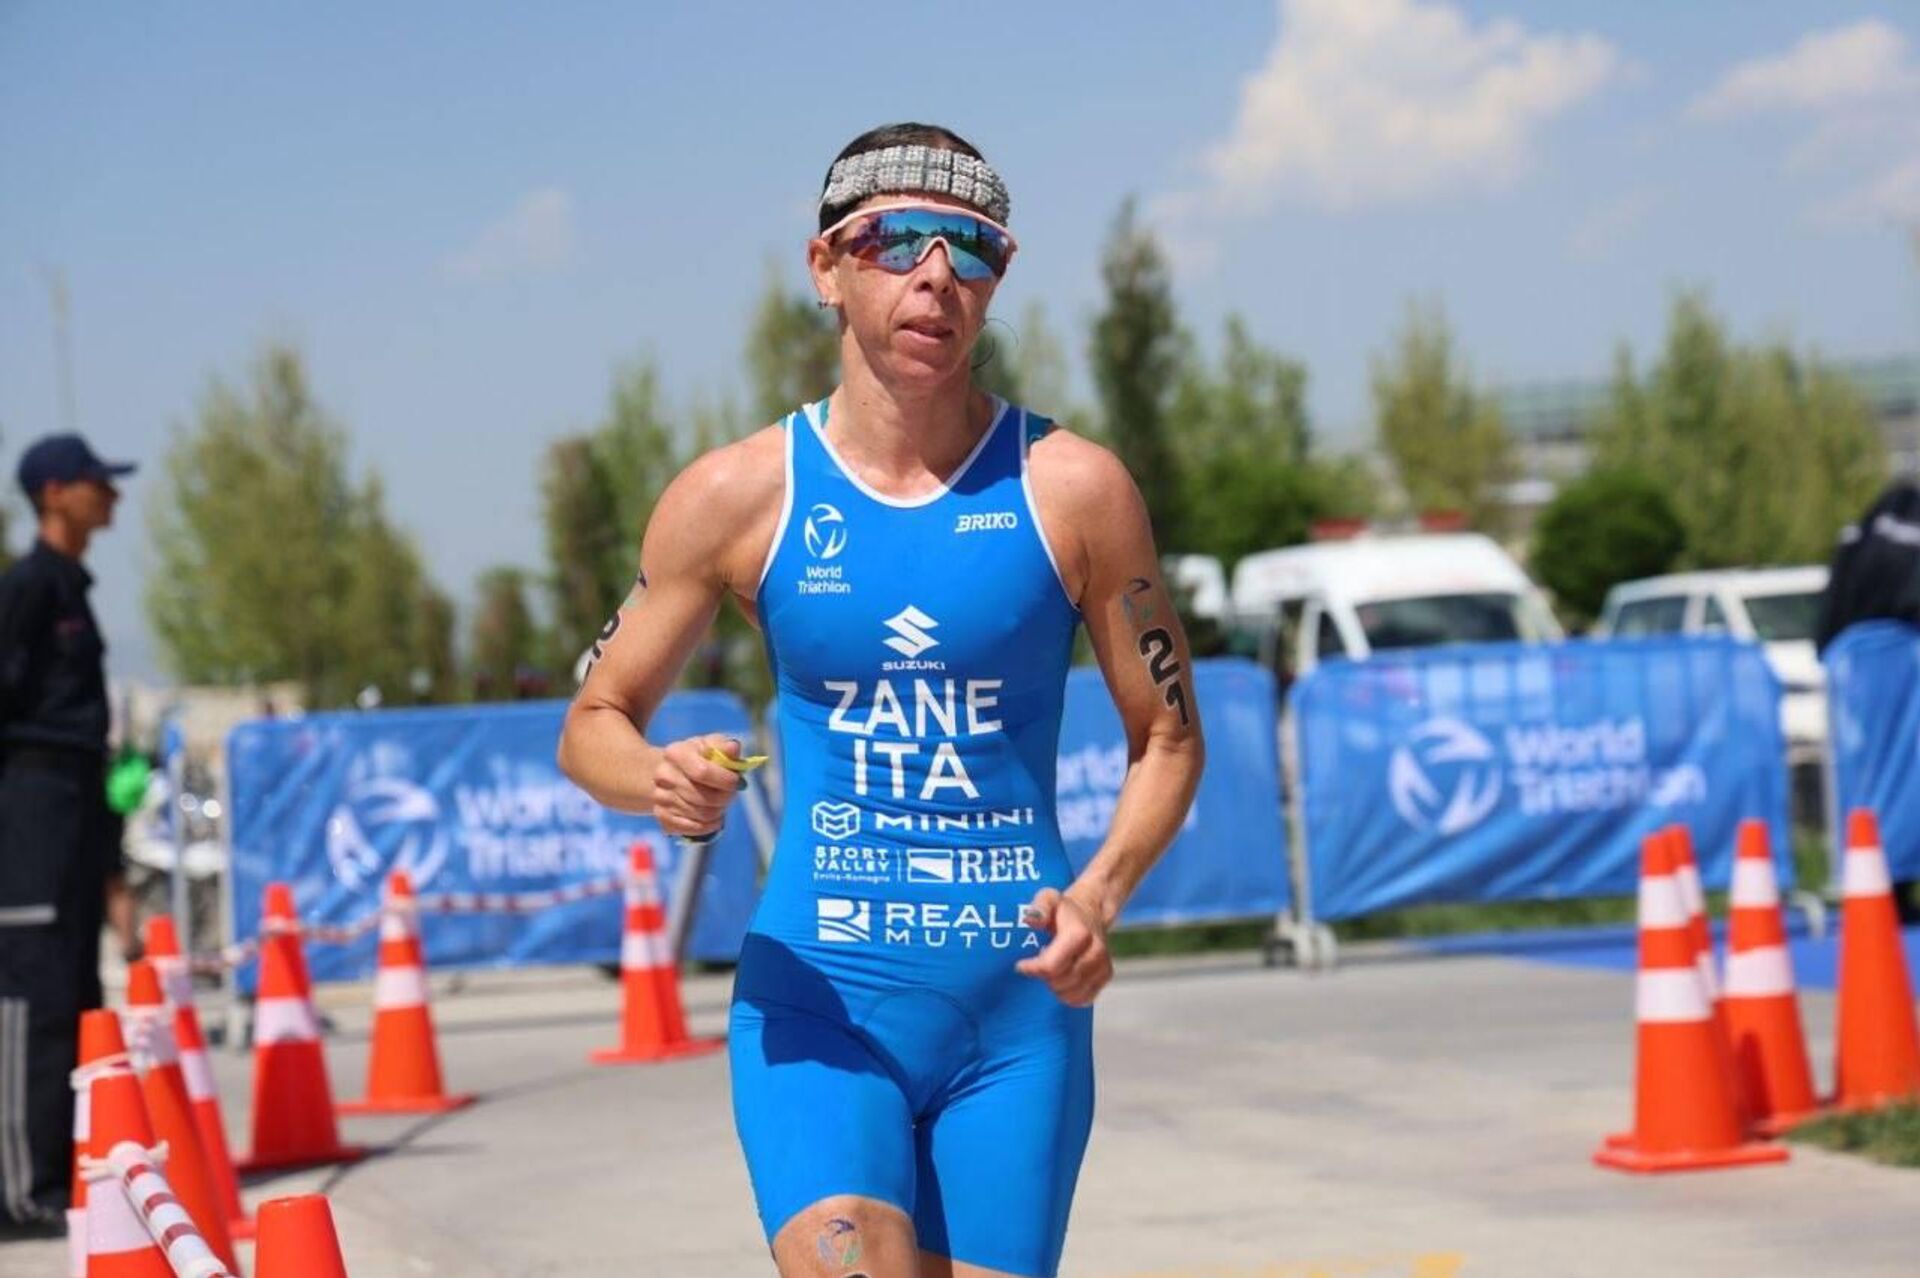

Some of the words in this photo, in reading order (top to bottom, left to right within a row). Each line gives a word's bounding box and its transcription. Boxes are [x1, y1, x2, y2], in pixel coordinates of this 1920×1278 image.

[955, 512, 1018, 533] BRIKO
[806, 565, 842, 579] World
[798, 580, 851, 594] Triathlon
[882, 660, 946, 671] SUZUKI
[824, 679, 1004, 738] ZANE
[853, 738, 981, 800] ITA
[874, 807, 1034, 832] MININI
[816, 846, 888, 860] SPORT
[815, 859, 890, 872] VALLEY
[885, 928, 1040, 948] MUTUA
